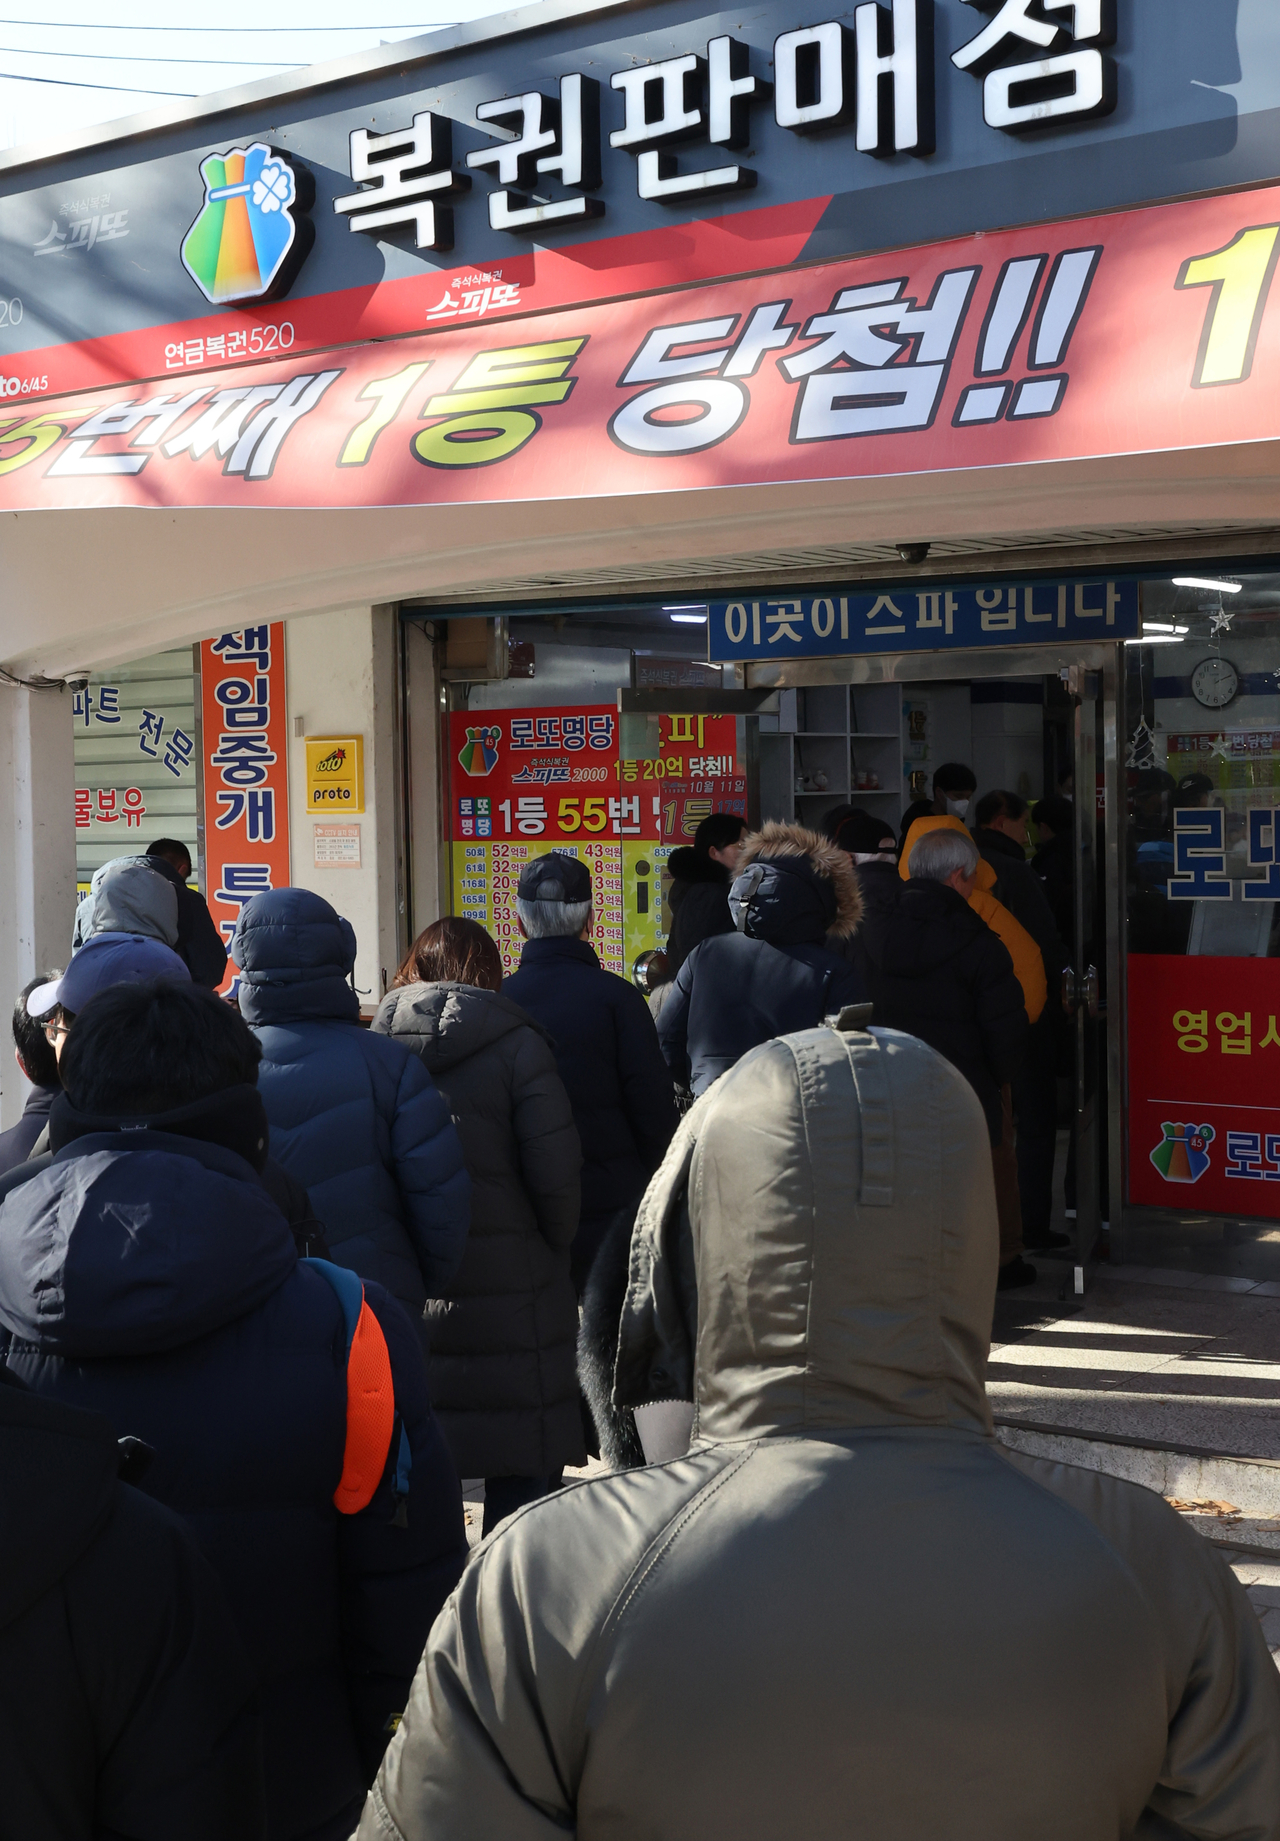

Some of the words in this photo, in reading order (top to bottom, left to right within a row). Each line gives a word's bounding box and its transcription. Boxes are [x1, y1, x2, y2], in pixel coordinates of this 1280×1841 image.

[58, 192, 111, 217] 즉석식복권
[33, 209, 130, 257] 스피또
[451, 269, 503, 289] 즉석식복권
[425, 282, 522, 321] 스피또
[0, 367, 347, 480] 5번째
[336, 334, 591, 470] 1등
[606, 245, 1104, 457] 당첨!!
[1174, 222, 1280, 388] 1
[164, 321, 295, 369] 연금복권520
[510, 714, 615, 751] 로또명당
[138, 708, 194, 778] 전문
[316, 757, 343, 772] toto
[531, 757, 570, 767] 즉석식복권
[613, 759, 639, 782] 1등
[643, 756, 683, 780] 20억
[690, 781, 714, 793] 10월
[720, 780, 745, 793] 11일
[313, 787, 351, 803] proto
[461, 799, 489, 815] 로또
[499, 797, 548, 834] 1등
[557, 796, 641, 834] 55번
[461, 819, 490, 836] 명당
[465, 847, 486, 858] 50회
[491, 844, 528, 858] 52억원
[584, 843, 622, 858] 43억원
[465, 863, 486, 873] 61회
[461, 878, 486, 889] 116회
[462, 894, 486, 905] 165회
[462, 910, 486, 920] 199회
[1191, 1137, 1203, 1148] 45
